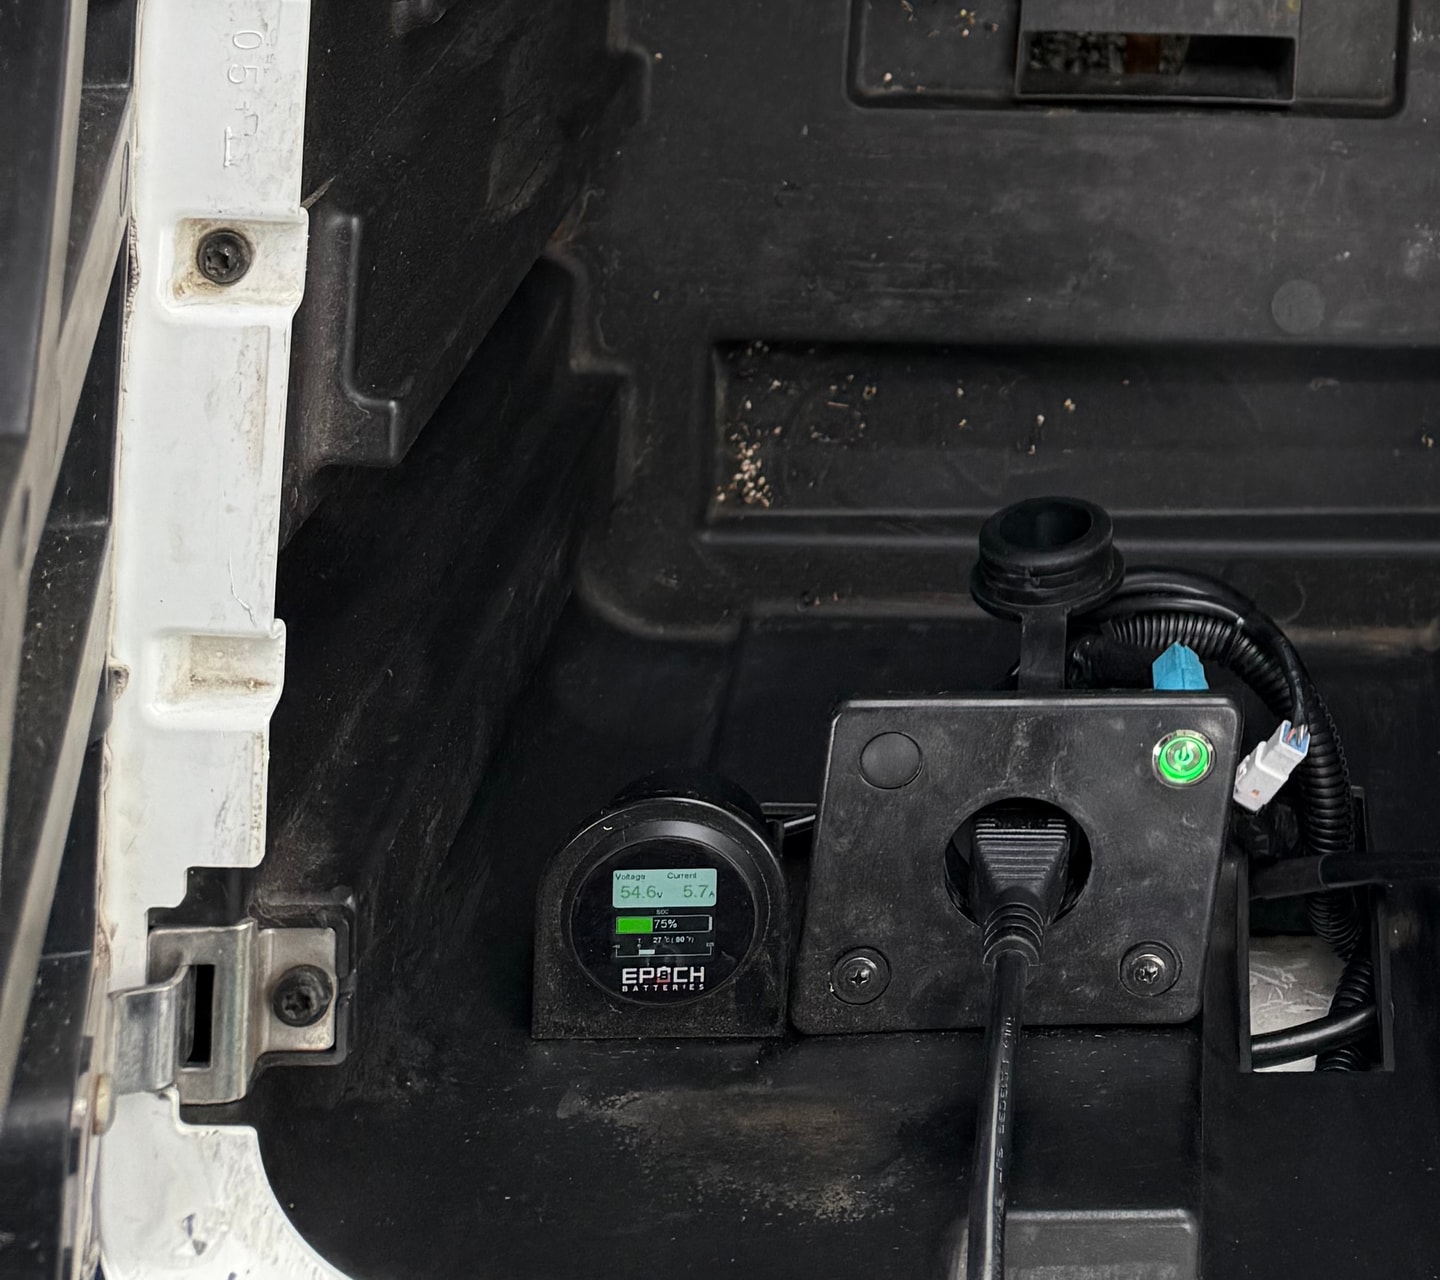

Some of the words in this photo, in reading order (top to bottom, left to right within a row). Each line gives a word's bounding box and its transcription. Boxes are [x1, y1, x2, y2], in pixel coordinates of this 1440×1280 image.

[614, 873, 646, 881] Voltage
[666, 872, 697, 880] Current
[654, 920, 678, 929] 75%
[622, 966, 705, 984] EPOCH
